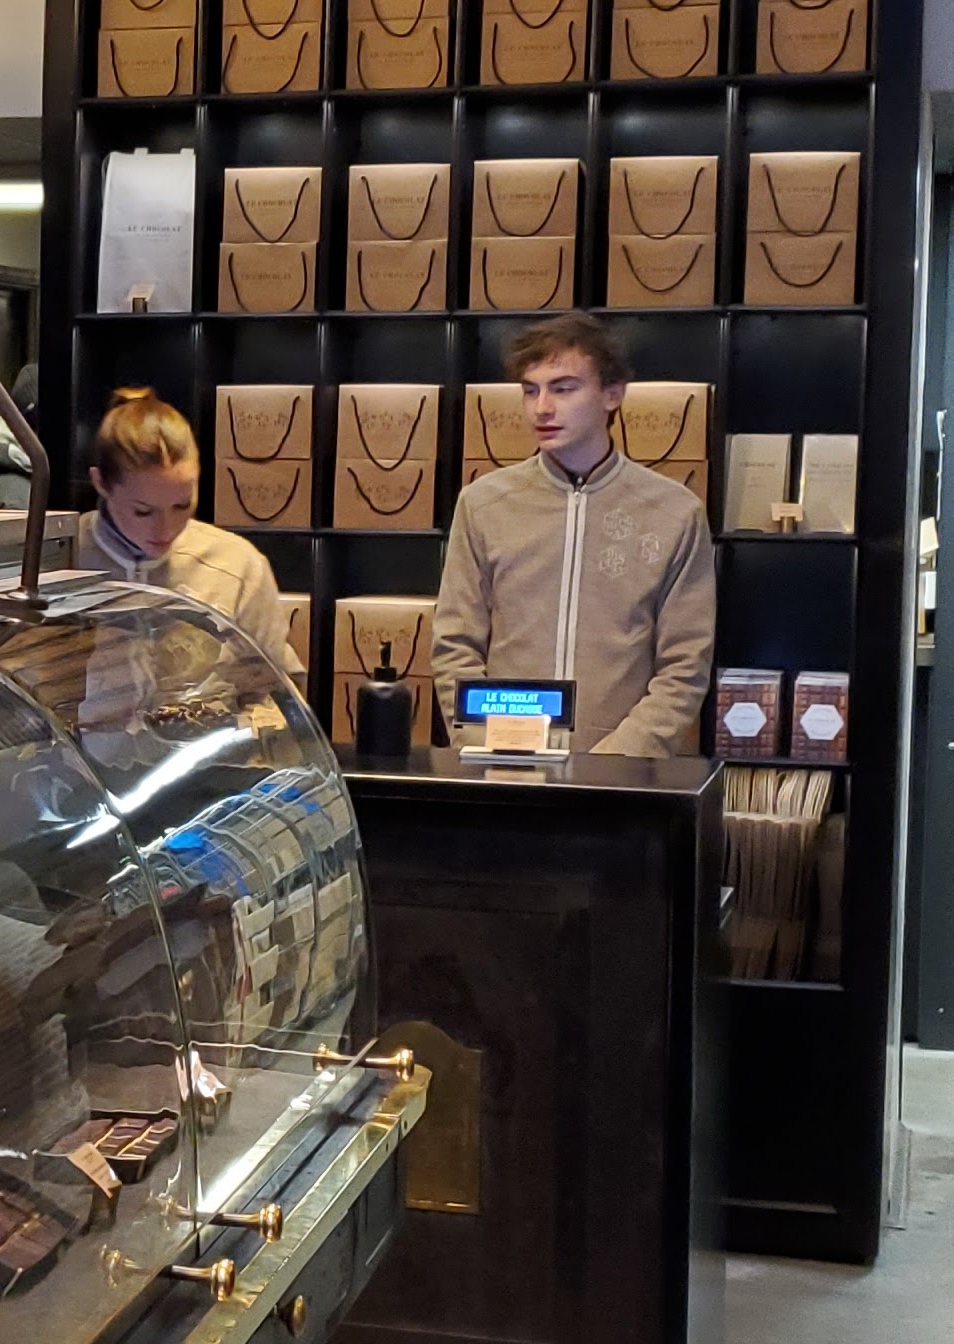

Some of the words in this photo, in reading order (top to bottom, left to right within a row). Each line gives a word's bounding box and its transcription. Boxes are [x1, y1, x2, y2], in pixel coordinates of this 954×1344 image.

[140, 224, 181, 233] CHOCOLAT
[486, 692, 497, 702] LE
[500, 693, 539, 703] CHOCOLAT
[481, 703, 506, 713] ALAIN
